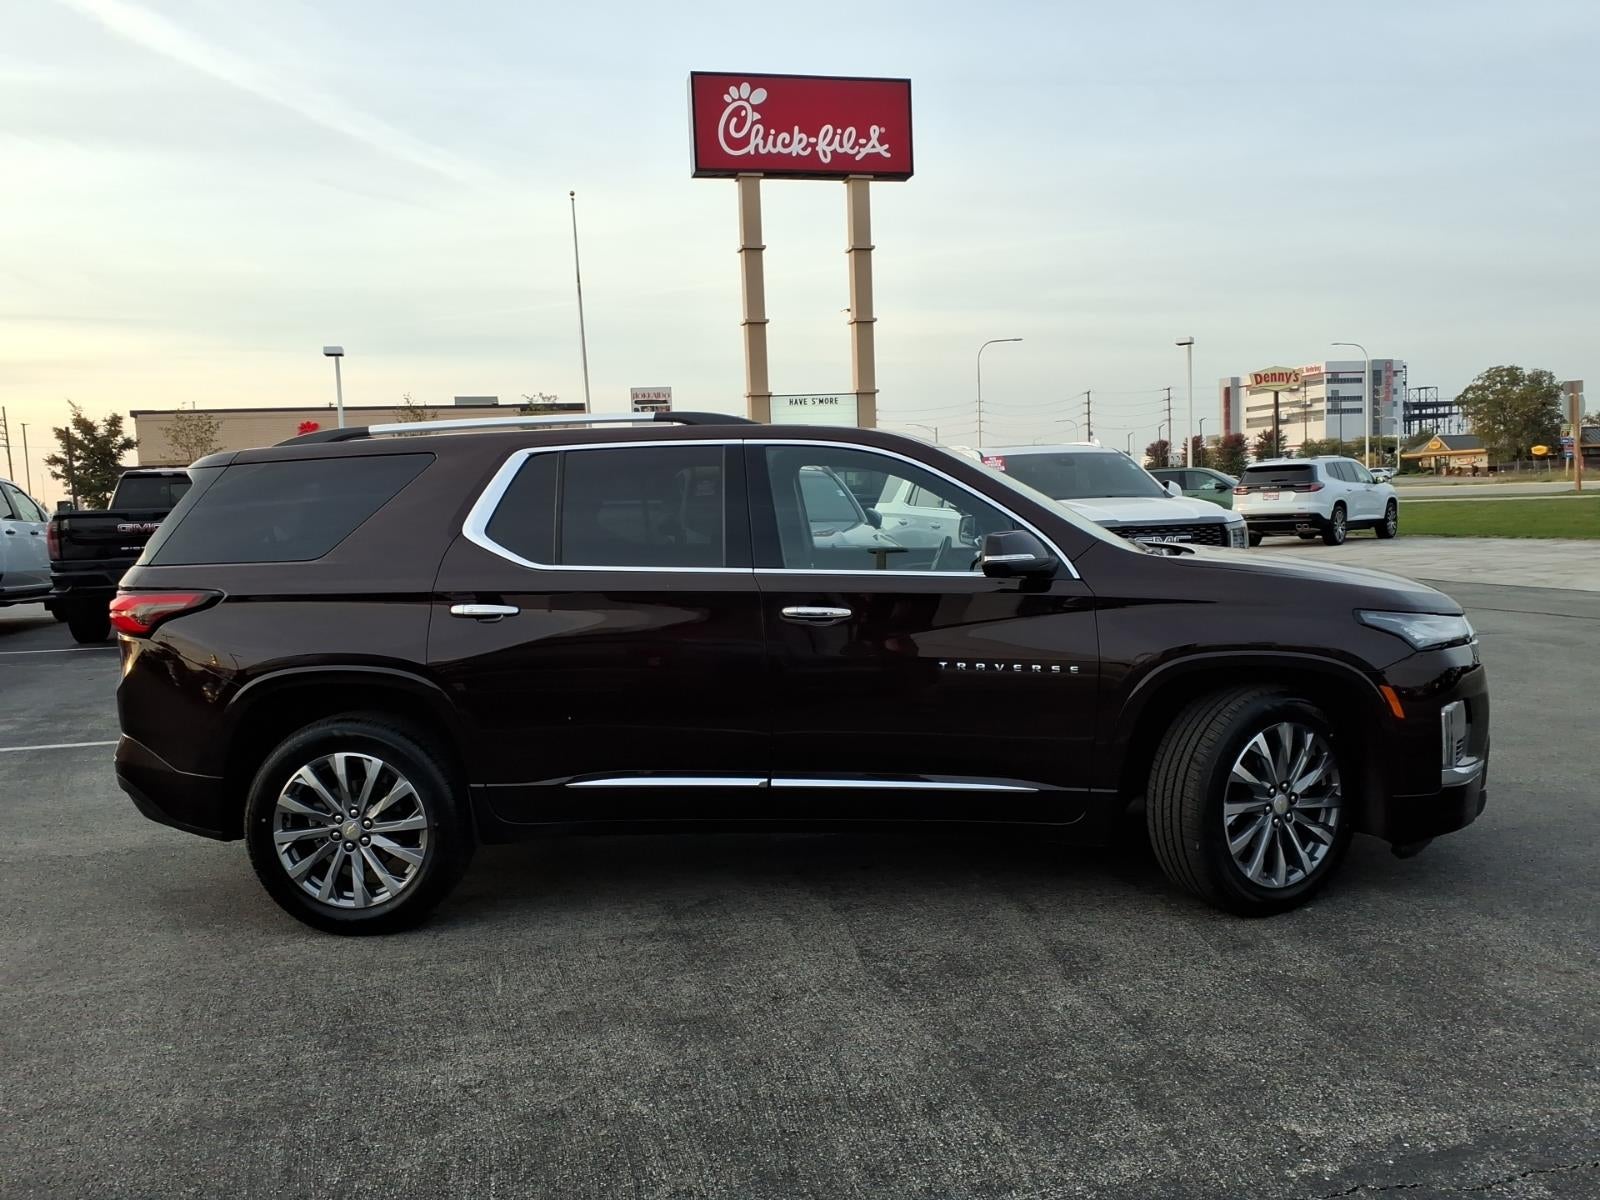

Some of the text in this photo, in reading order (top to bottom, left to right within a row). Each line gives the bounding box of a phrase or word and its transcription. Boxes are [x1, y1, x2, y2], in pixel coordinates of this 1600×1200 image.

[718, 98, 892, 164] Chick-fil-A
[1253, 370, 1301, 386] Denny's
[811, 397, 839, 405] S'MORE
[938, 661, 1080, 674] TRAVERSE
